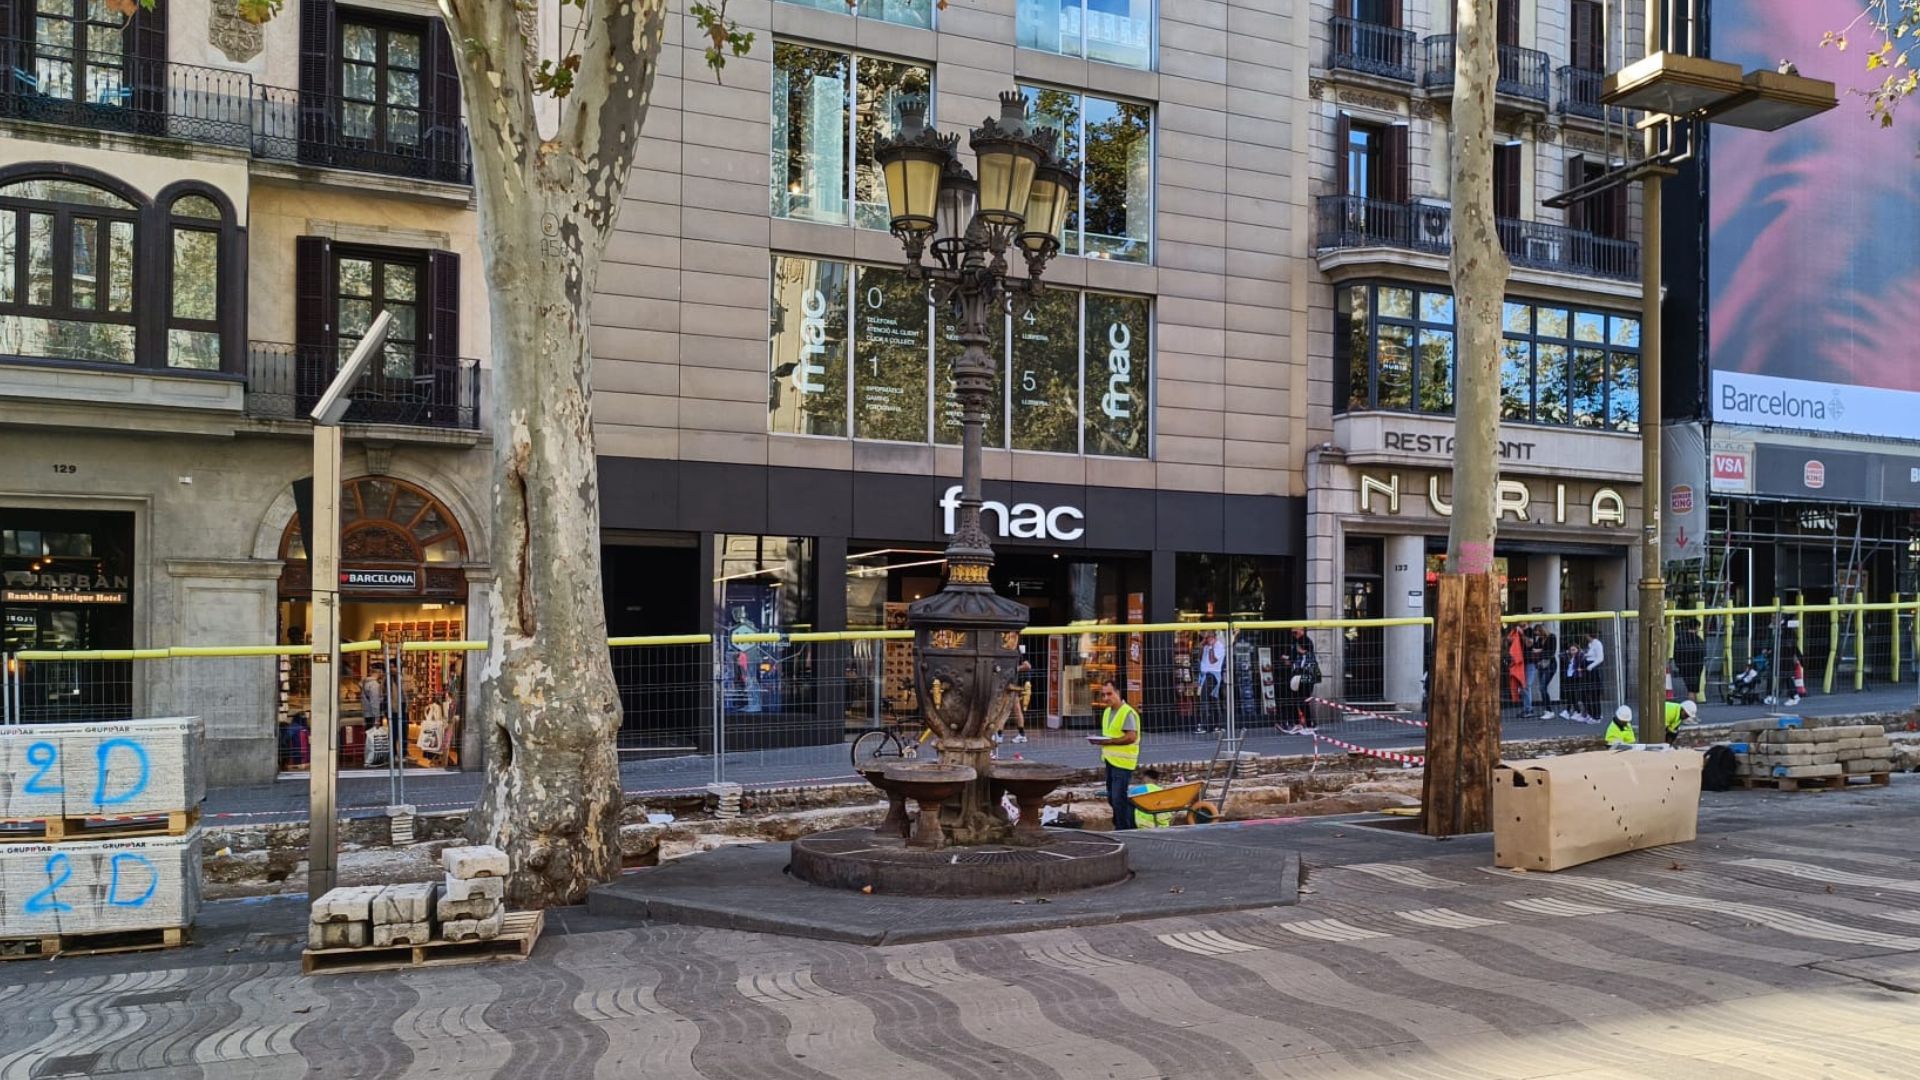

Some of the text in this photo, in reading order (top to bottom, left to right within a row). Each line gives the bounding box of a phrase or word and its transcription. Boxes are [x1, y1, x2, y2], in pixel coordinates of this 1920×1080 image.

[867, 286, 883, 309] 0
[1023, 308, 1037, 326] 4
[792, 289, 826, 394] fnac
[868, 355, 878, 378] 1
[1101, 322, 1131, 420] fnac
[1022, 370, 1037, 392] 5
[1721, 383, 1826, 420] Barcelona
[1384, 431, 1536, 460] RESTAANT
[52, 464, 77, 474] 129
[1716, 456, 1743, 473] VSA
[1361, 473, 1626, 525] NURIA
[939, 485, 1085, 541] fnac
[348, 573, 414, 584] BARCELONA
[7, 592, 121, 603] Ramblas Boutique Hotel
[24, 738, 149, 805] 2 D
[24, 852, 159, 912] 2 D
